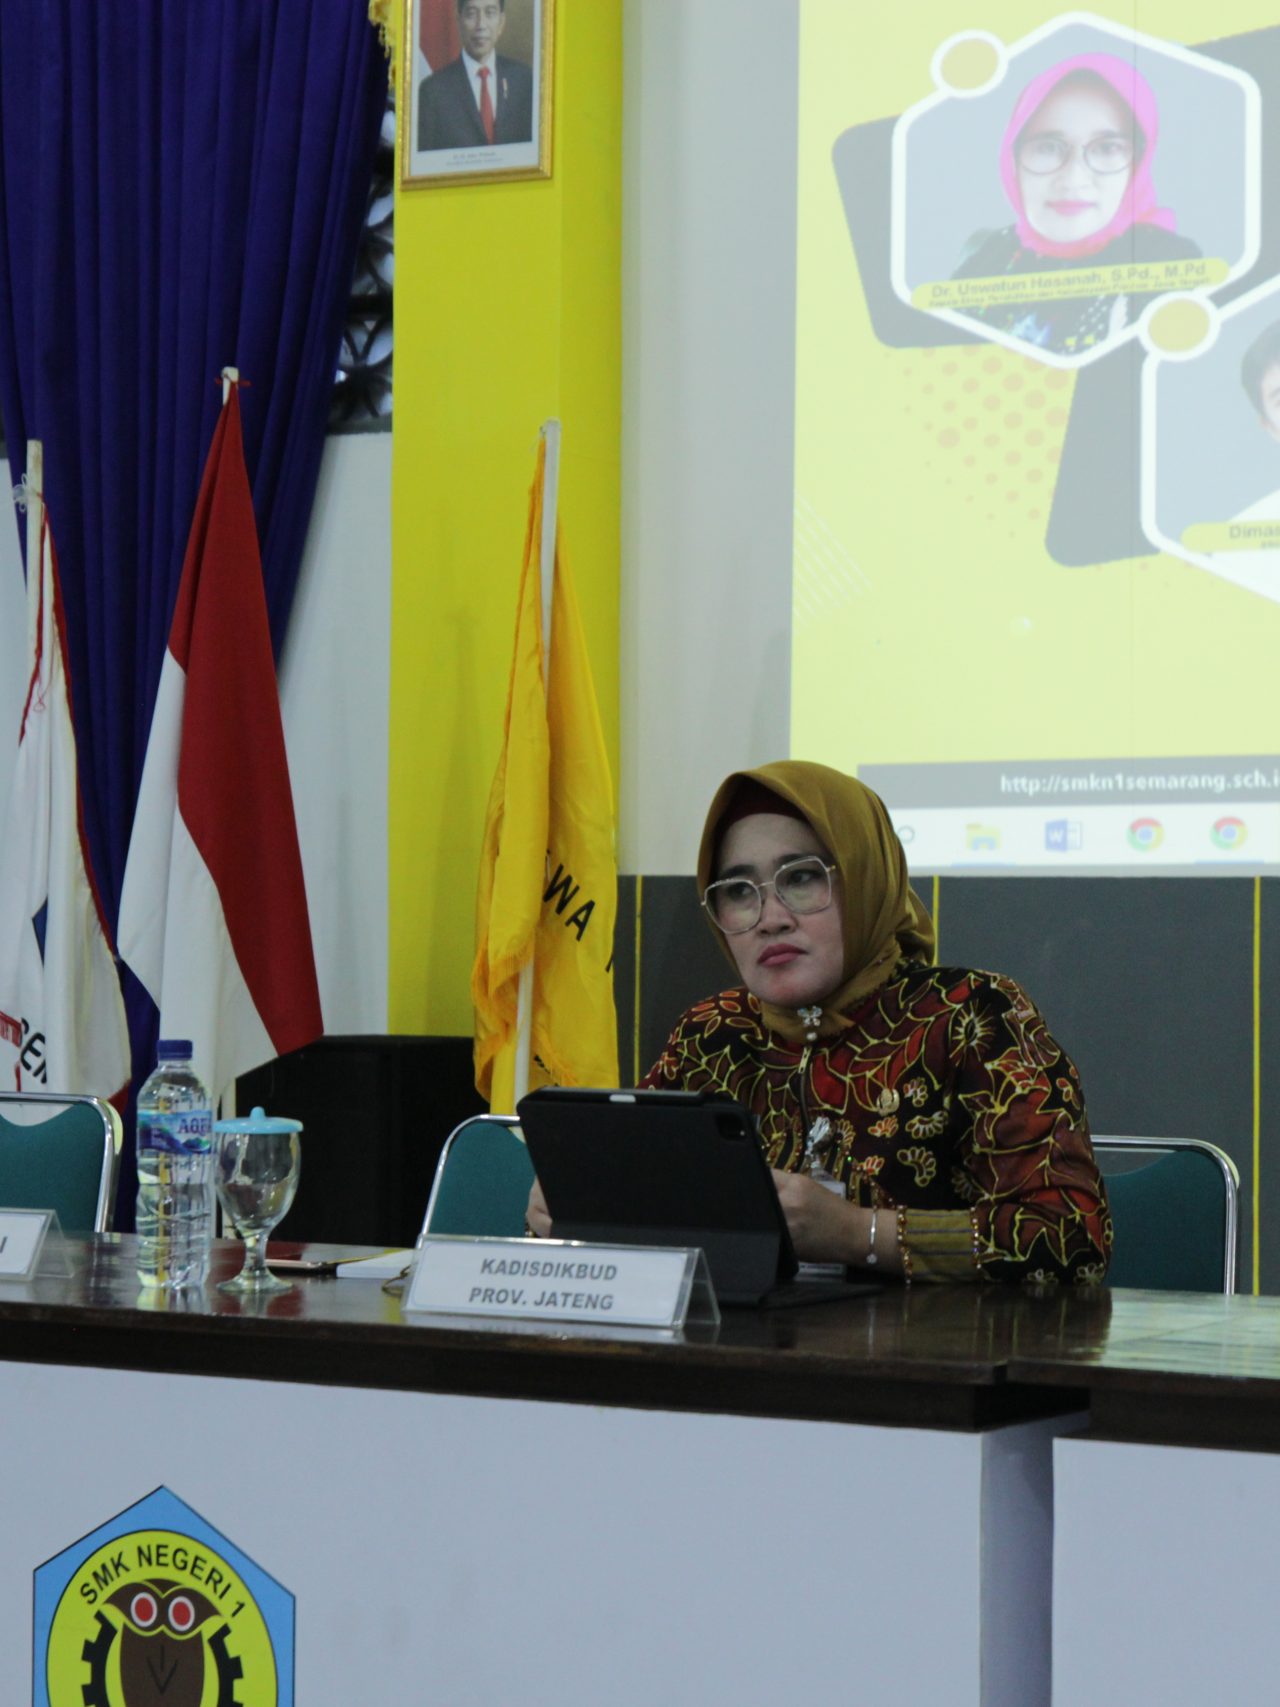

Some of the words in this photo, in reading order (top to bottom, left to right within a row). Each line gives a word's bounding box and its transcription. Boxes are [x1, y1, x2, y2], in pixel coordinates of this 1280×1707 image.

[932, 284, 951, 298] Dr.
[480, 1258, 618, 1281] KADISDIKBUD
[468, 1287, 526, 1306] PROV.
[534, 1290, 614, 1311] JATENG
[80, 1551, 131, 1605] SMK
[137, 1543, 232, 1599] NEGERI
[230, 1600, 245, 1618] 1
